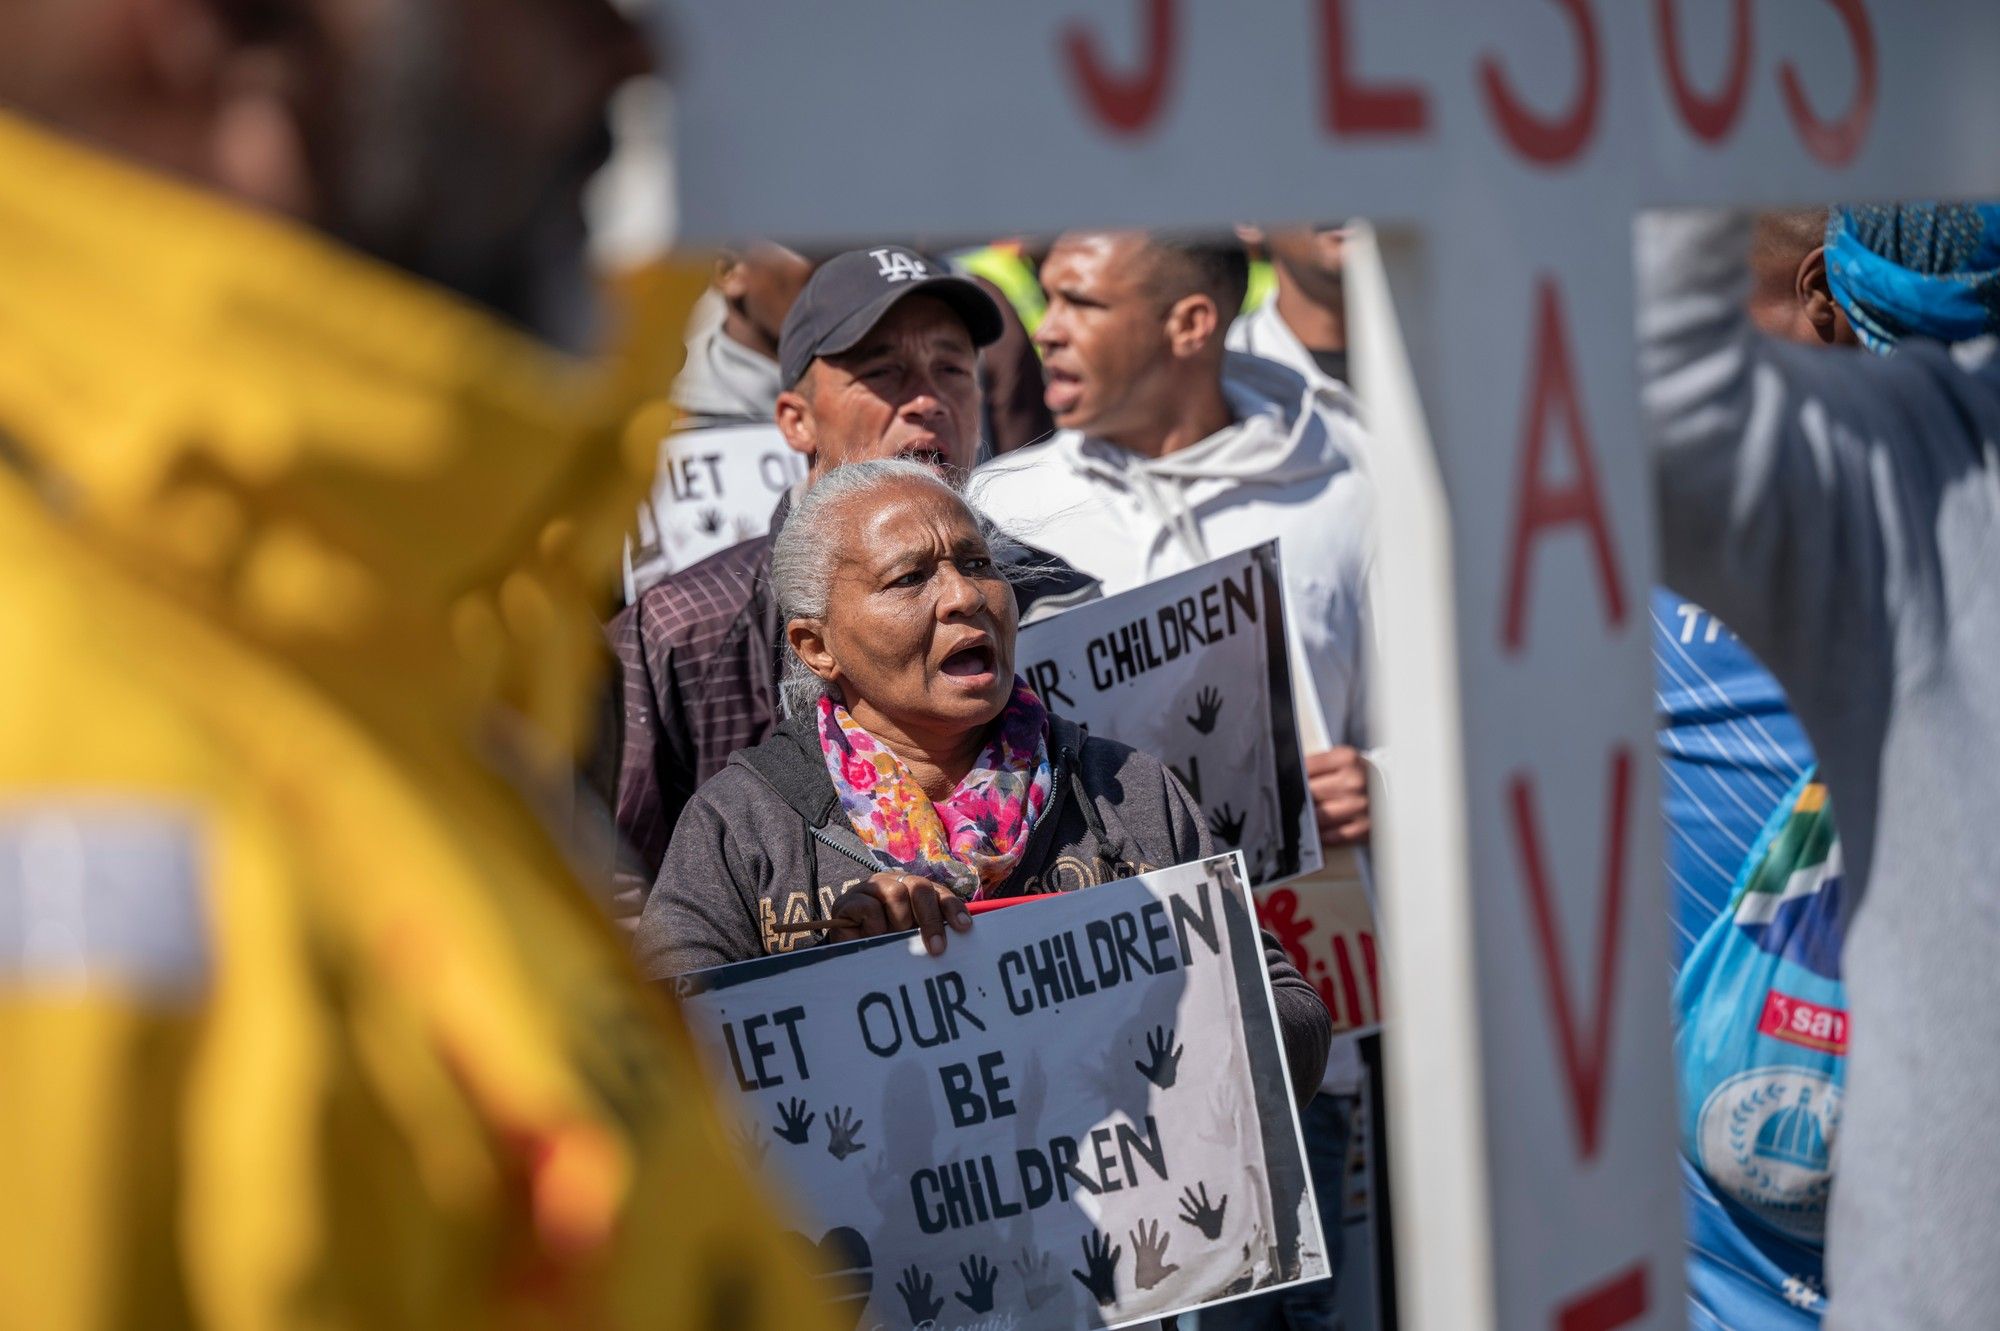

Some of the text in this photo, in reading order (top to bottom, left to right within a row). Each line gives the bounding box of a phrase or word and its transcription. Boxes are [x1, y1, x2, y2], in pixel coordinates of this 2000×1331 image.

[868, 248, 929, 282] LA
[667, 454, 723, 502] LET
[722, 1005, 810, 1092] LET
[856, 970, 987, 1058] OUR
[938, 1050, 1017, 1129] BE
